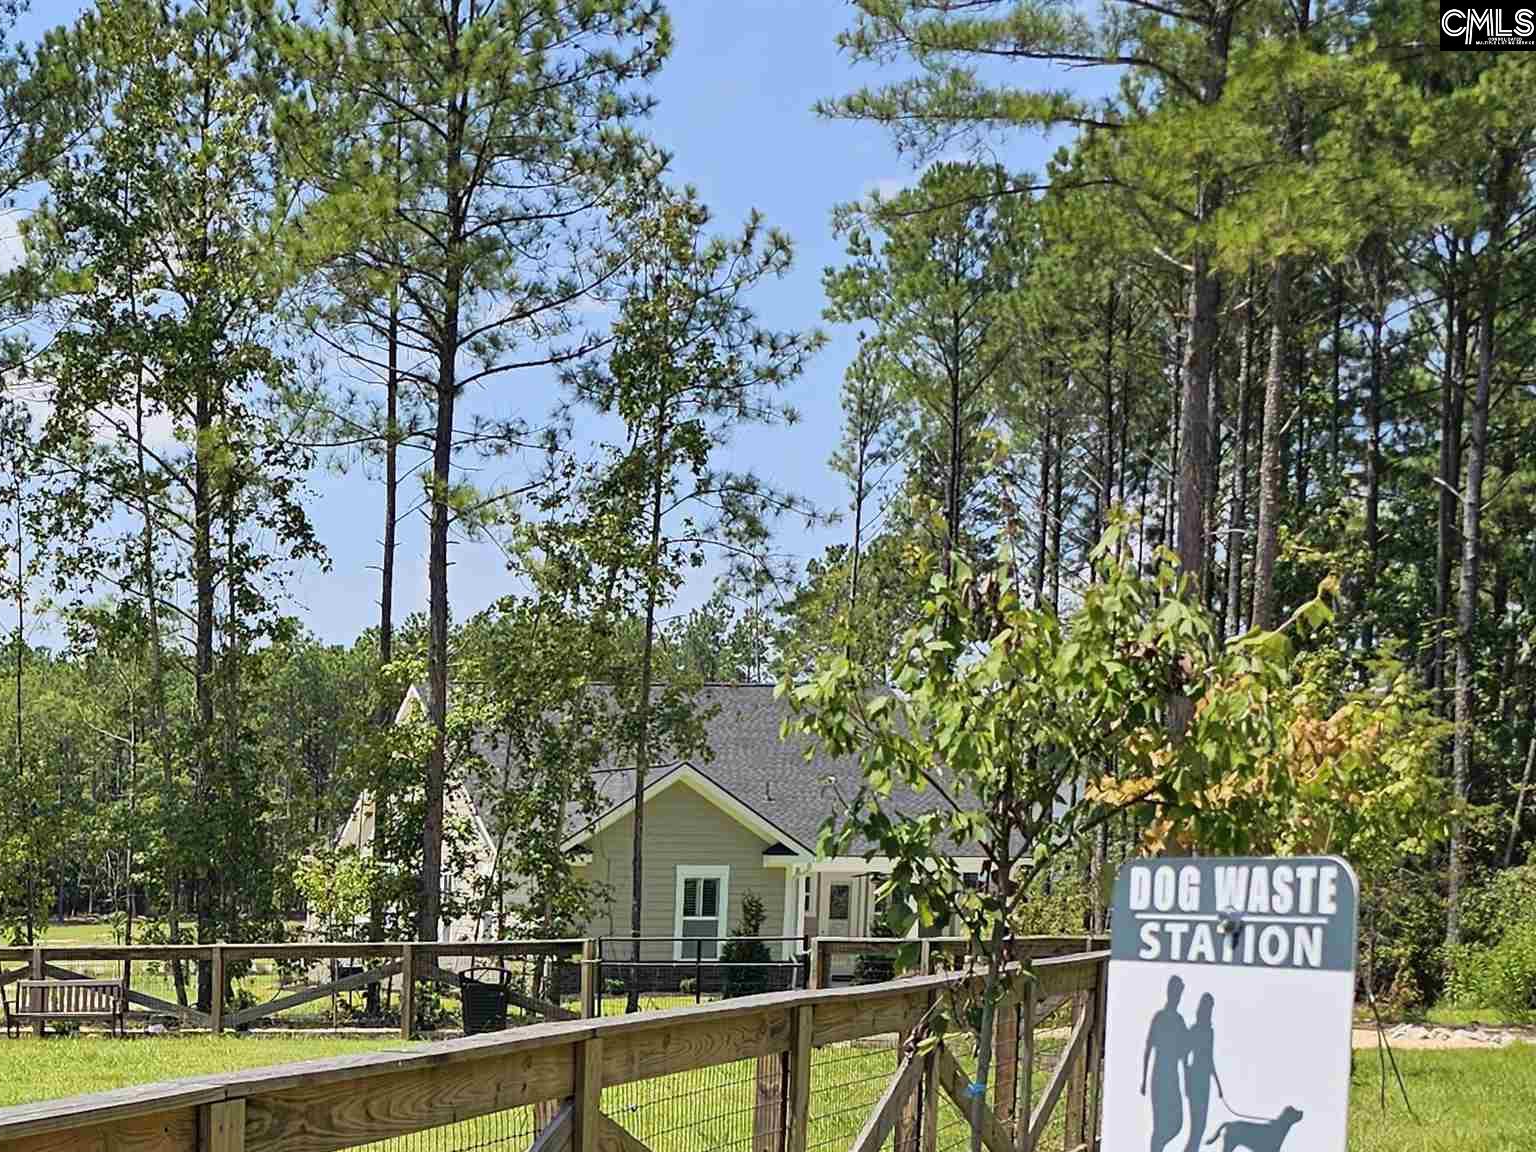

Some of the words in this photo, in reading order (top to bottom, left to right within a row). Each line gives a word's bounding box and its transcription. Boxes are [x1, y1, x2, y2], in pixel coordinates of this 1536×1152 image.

[1129, 865, 1201, 912] DOG
[1214, 865, 1338, 915] WASTE
[1139, 921, 1324, 968] STATION
